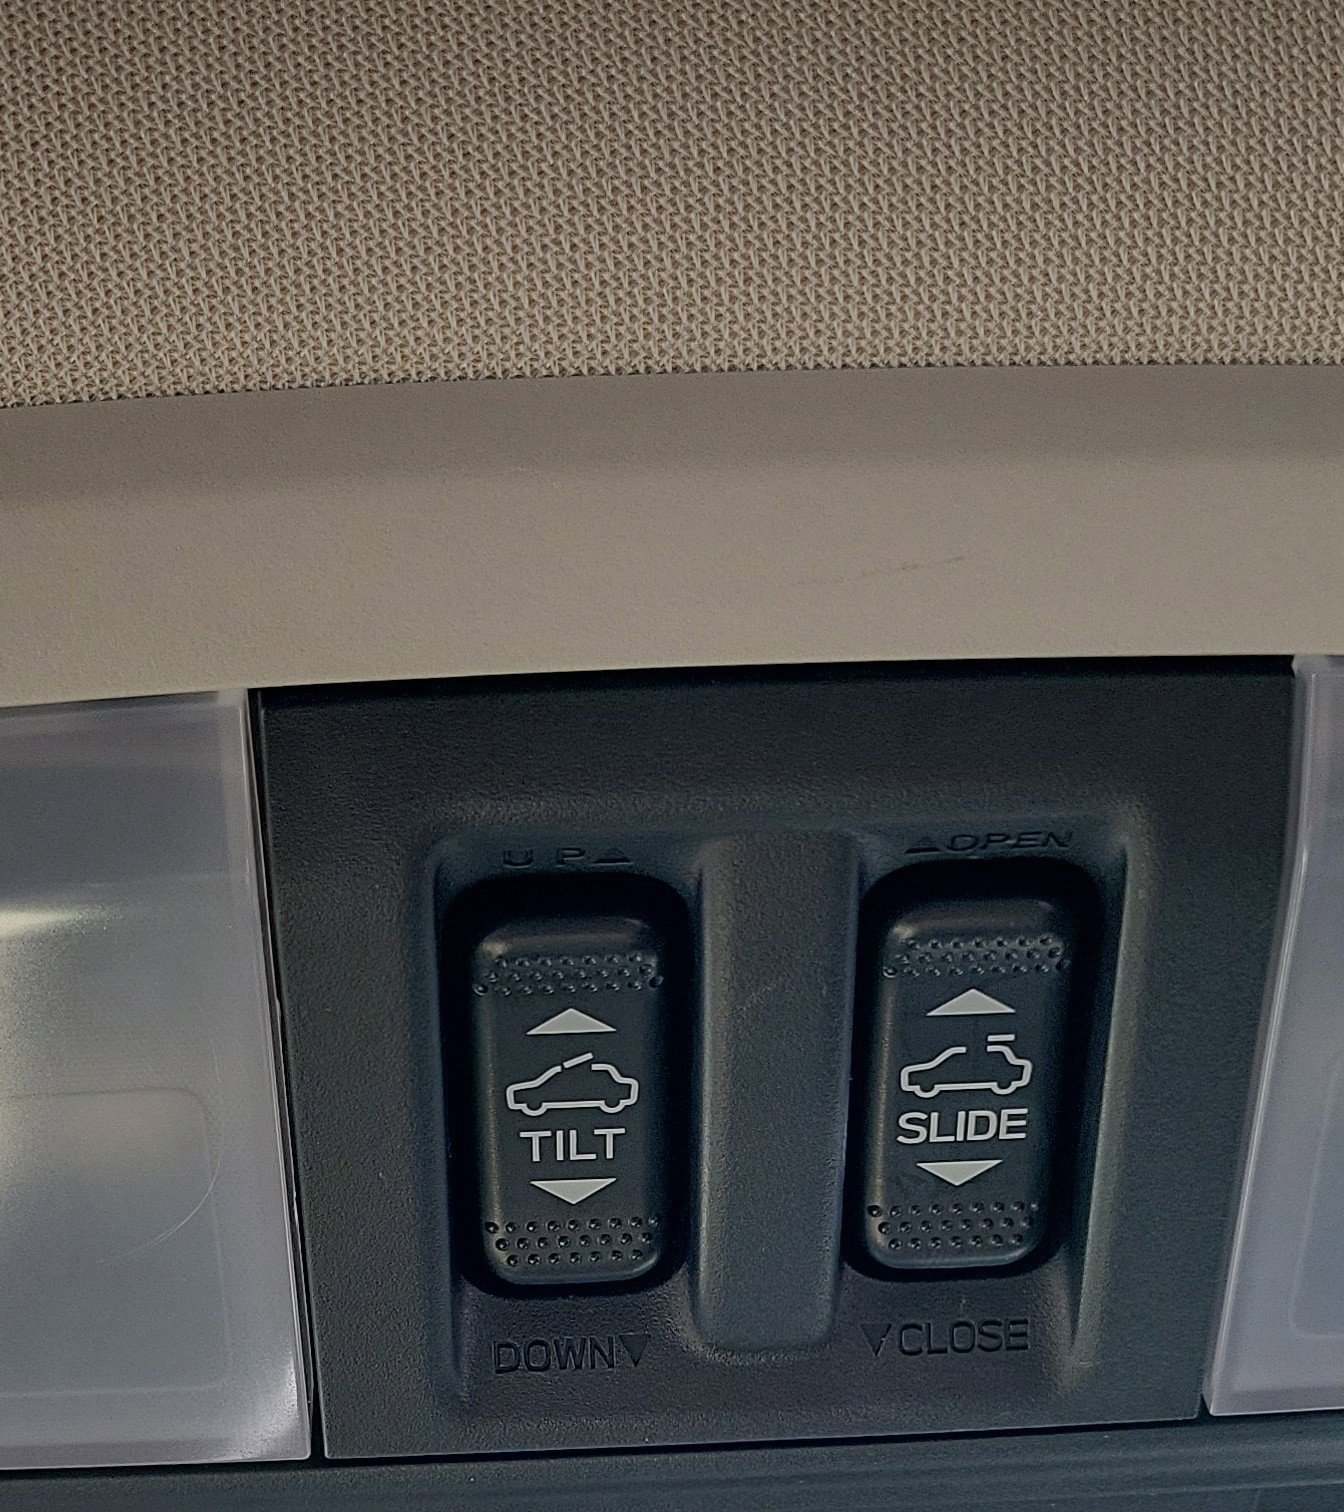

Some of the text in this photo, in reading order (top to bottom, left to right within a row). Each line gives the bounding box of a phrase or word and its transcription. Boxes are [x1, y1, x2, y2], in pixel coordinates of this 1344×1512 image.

[946, 830, 1073, 852] OPEN
[896, 1109, 1028, 1144] SLIDE
[519, 1127, 626, 1162] TILT
[492, 1334, 617, 1375] DOWN
[897, 1318, 1030, 1357] CLOSE
